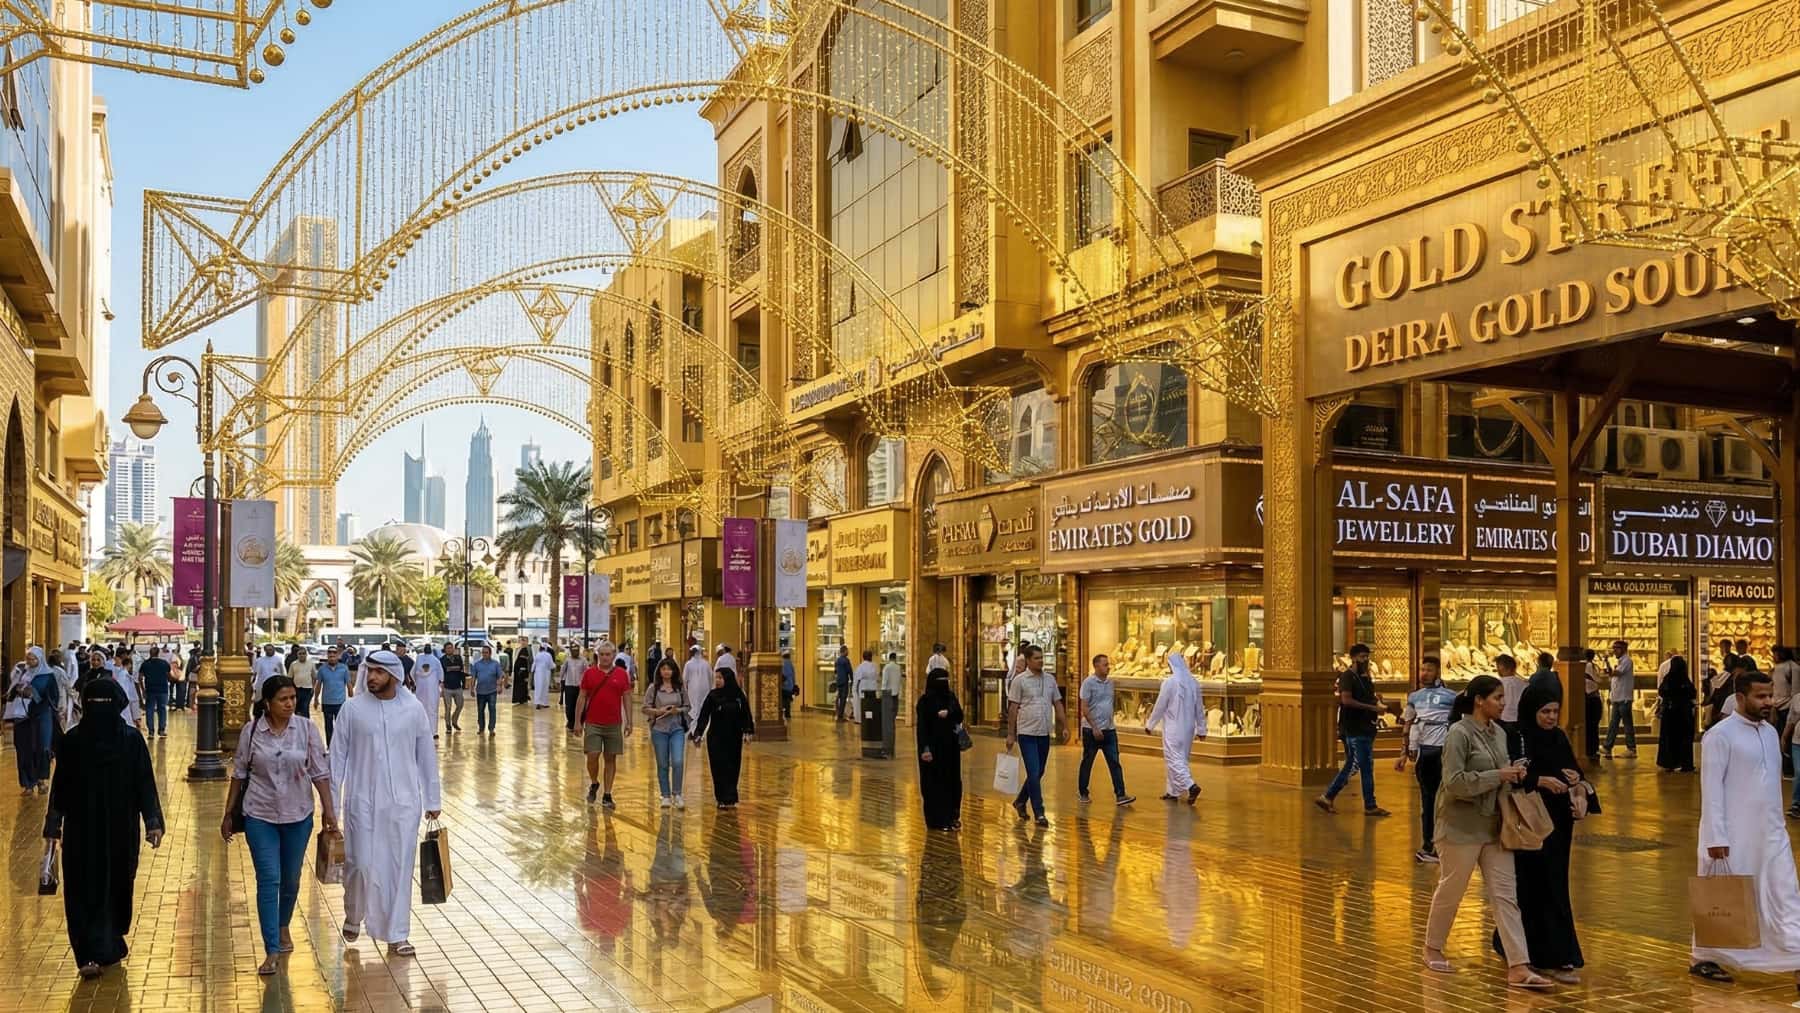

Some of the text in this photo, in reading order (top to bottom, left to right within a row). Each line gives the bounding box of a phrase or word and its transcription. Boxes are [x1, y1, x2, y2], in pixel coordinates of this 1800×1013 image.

[1336, 223, 1486, 310] GOLD
[1345, 241, 1755, 372] DEIRA GOLD SOUK
[1336, 480, 1456, 514] AL-SAFA
[1049, 521, 1133, 551] EMIRATES
[1138, 515, 1192, 543] GOLD
[1336, 519, 1456, 545] JEWELLERY
[1476, 527, 1548, 551] EMIRATES
[1612, 530, 1688, 558] DUBAI
[1695, 534, 1774, 561] DIAMO
[1745, 585, 1775, 599] GOLD
